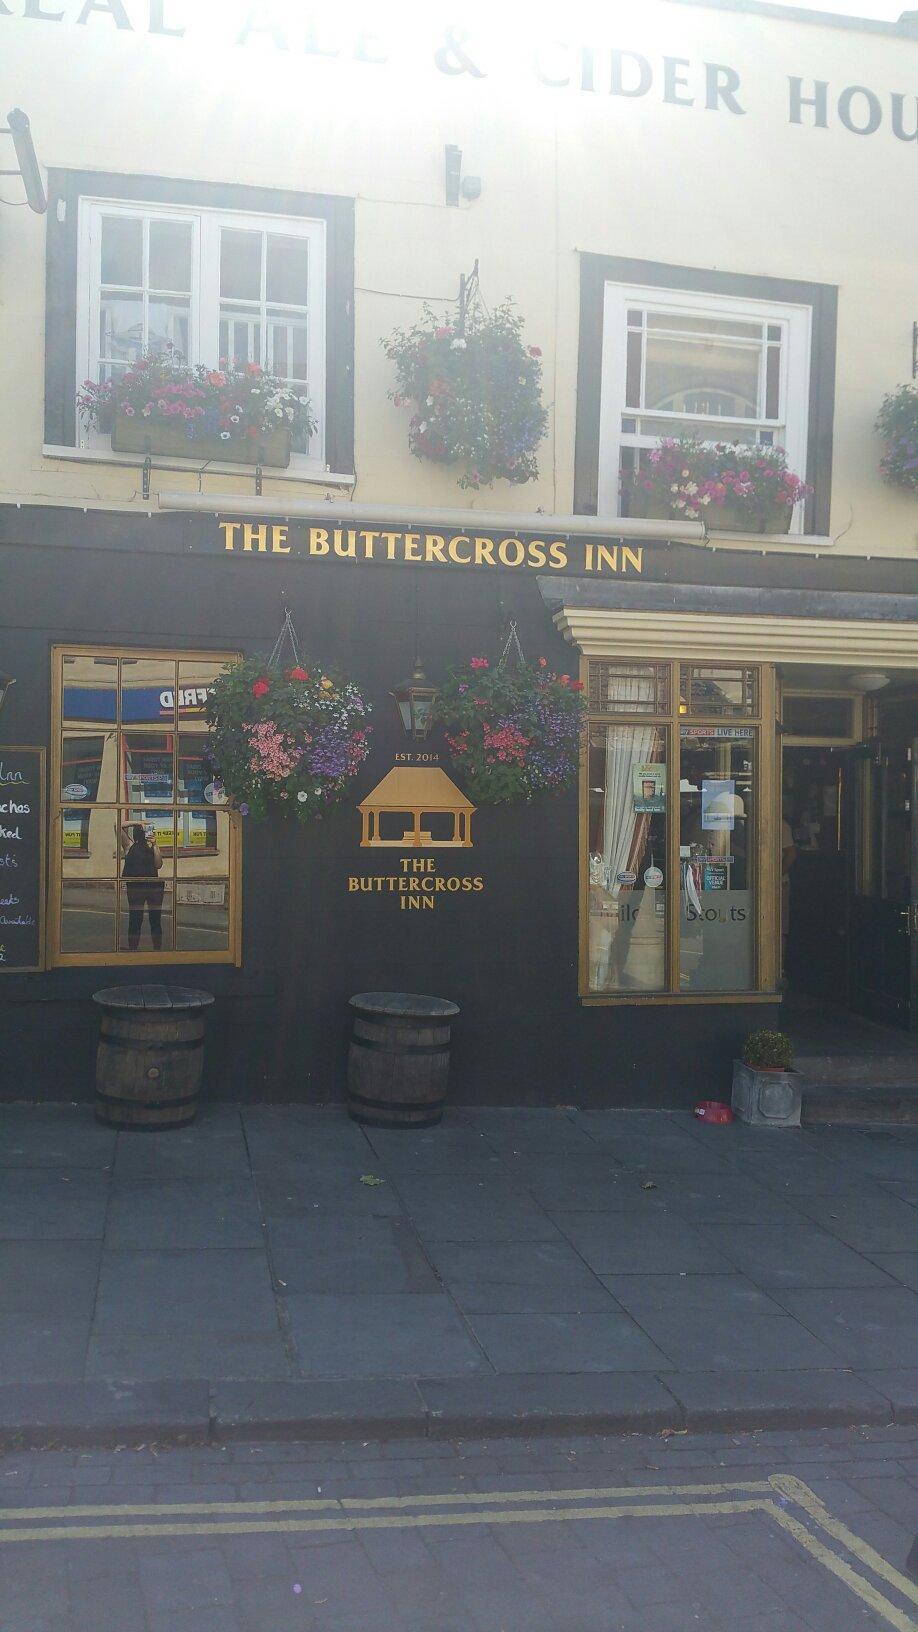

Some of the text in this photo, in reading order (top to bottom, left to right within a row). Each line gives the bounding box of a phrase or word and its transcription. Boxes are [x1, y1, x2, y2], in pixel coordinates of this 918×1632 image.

[233, 5, 389, 65] ALE
[434, 24, 489, 79] &
[532, 40, 747, 115] CIDER
[786, 75, 918, 143] HOU
[218, 521, 644, 574] THE BUTTERCROSS INN
[716, 728, 733, 737] LIVE
[734, 727, 754, 738] HERE
[395, 753, 440, 762] EST. 2014
[0, 799, 31, 814] chos
[399, 858, 436, 873] THE
[347, 877, 484, 892] BUTTERCROSS
[400, 895, 435, 910] INN
